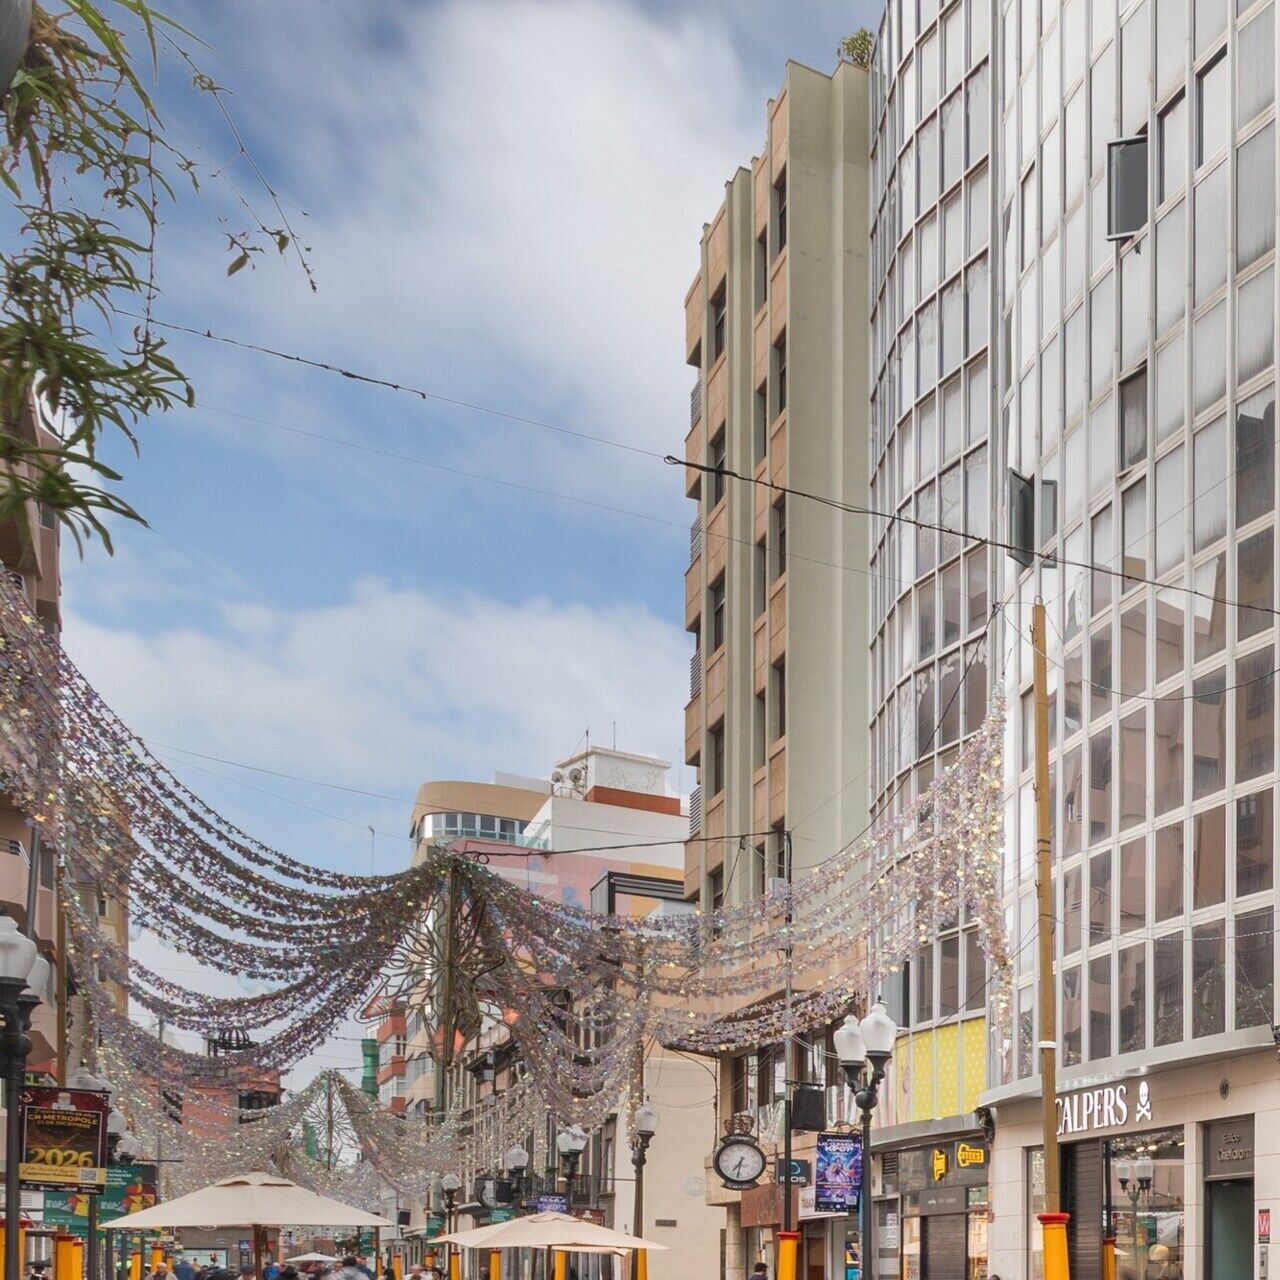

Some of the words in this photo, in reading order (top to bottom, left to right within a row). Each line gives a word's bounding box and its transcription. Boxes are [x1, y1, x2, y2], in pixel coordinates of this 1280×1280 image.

[43, 1114, 98, 1126] METROPOLE
[1055, 1085, 1128, 1135] CALPERS
[29, 1148, 94, 1168] 2026
